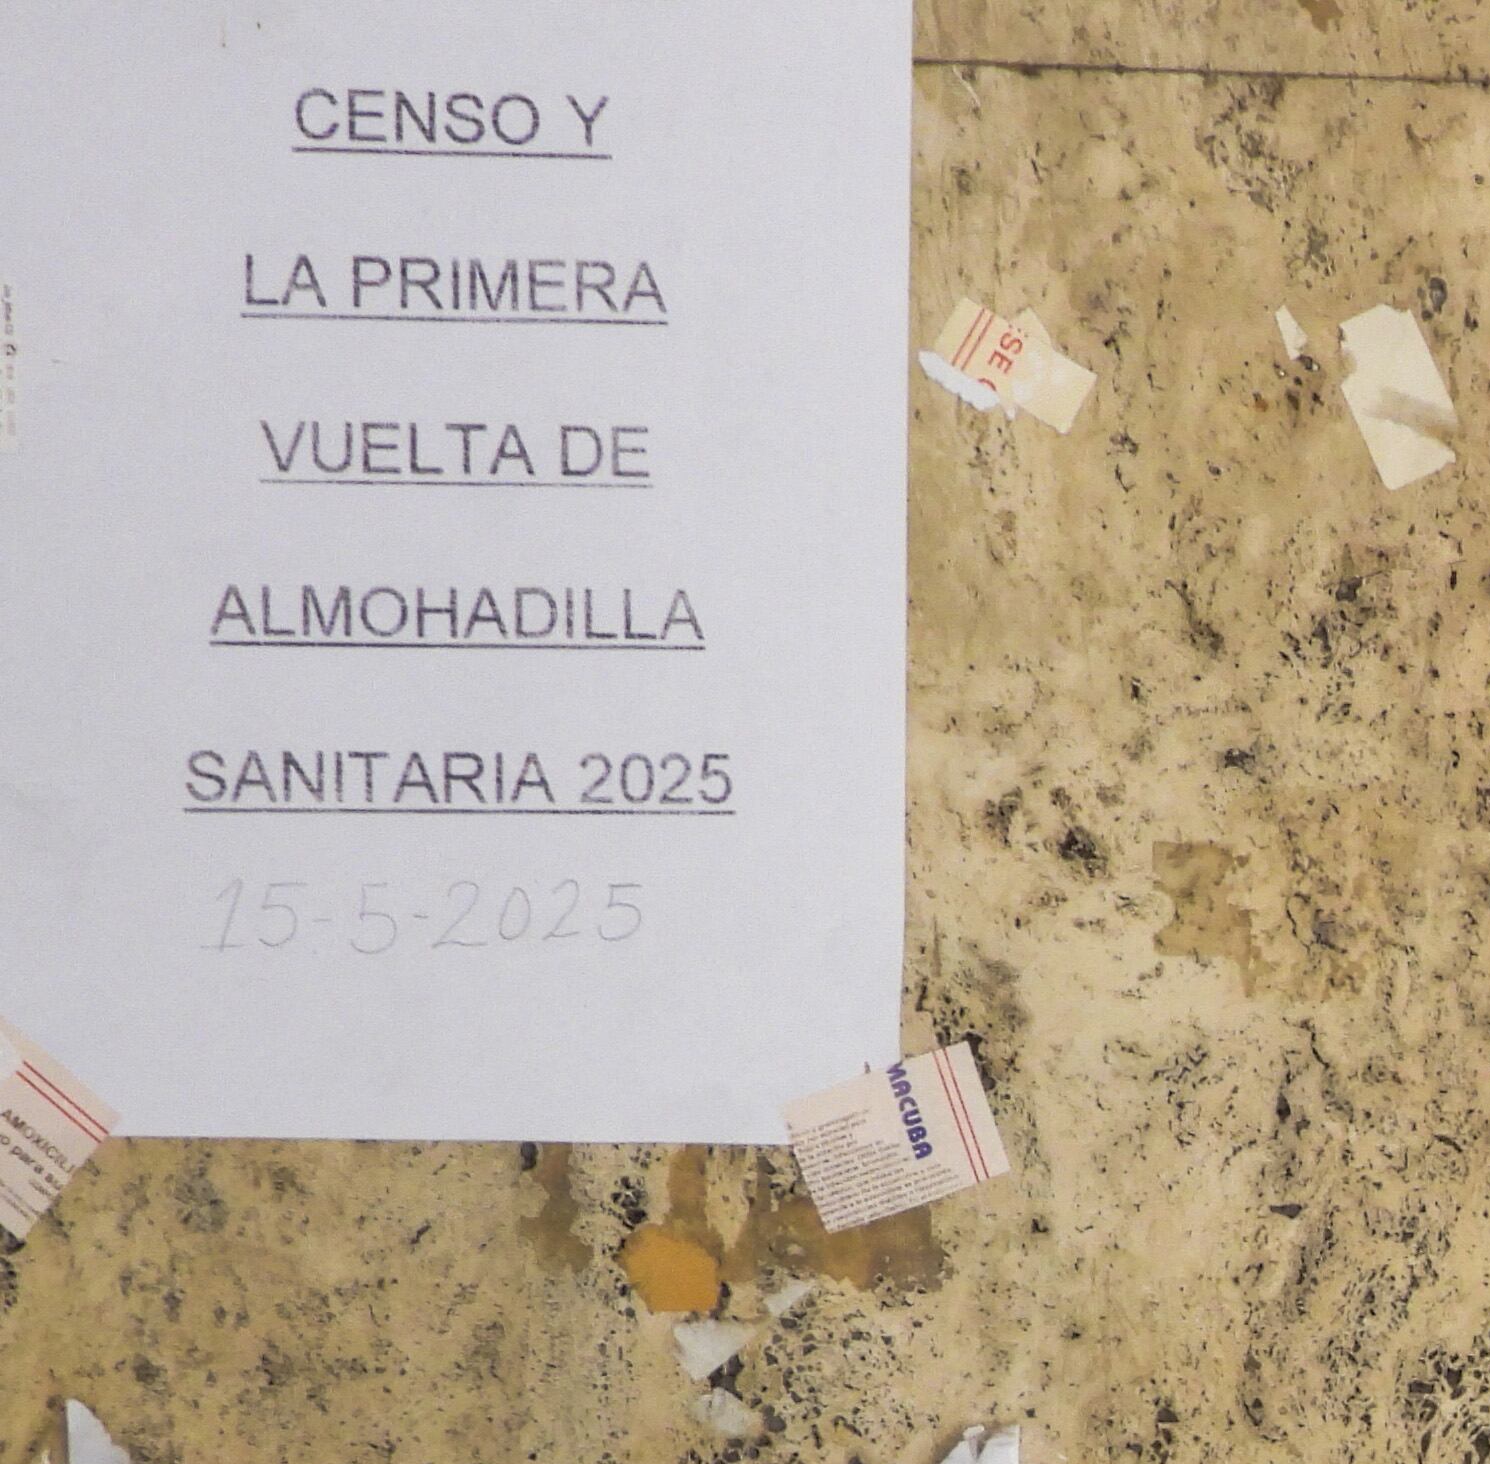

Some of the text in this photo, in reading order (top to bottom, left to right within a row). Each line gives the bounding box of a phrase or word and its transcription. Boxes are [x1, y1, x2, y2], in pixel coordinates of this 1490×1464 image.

[295, 87, 610, 147] CENSO Y
[245, 253, 668, 314] LA PRIMERA
[260, 420, 652, 480] VUELTA DE
[210, 584, 706, 641] ALMOHADILLA
[185, 749, 734, 805] SANITARIA 2025
